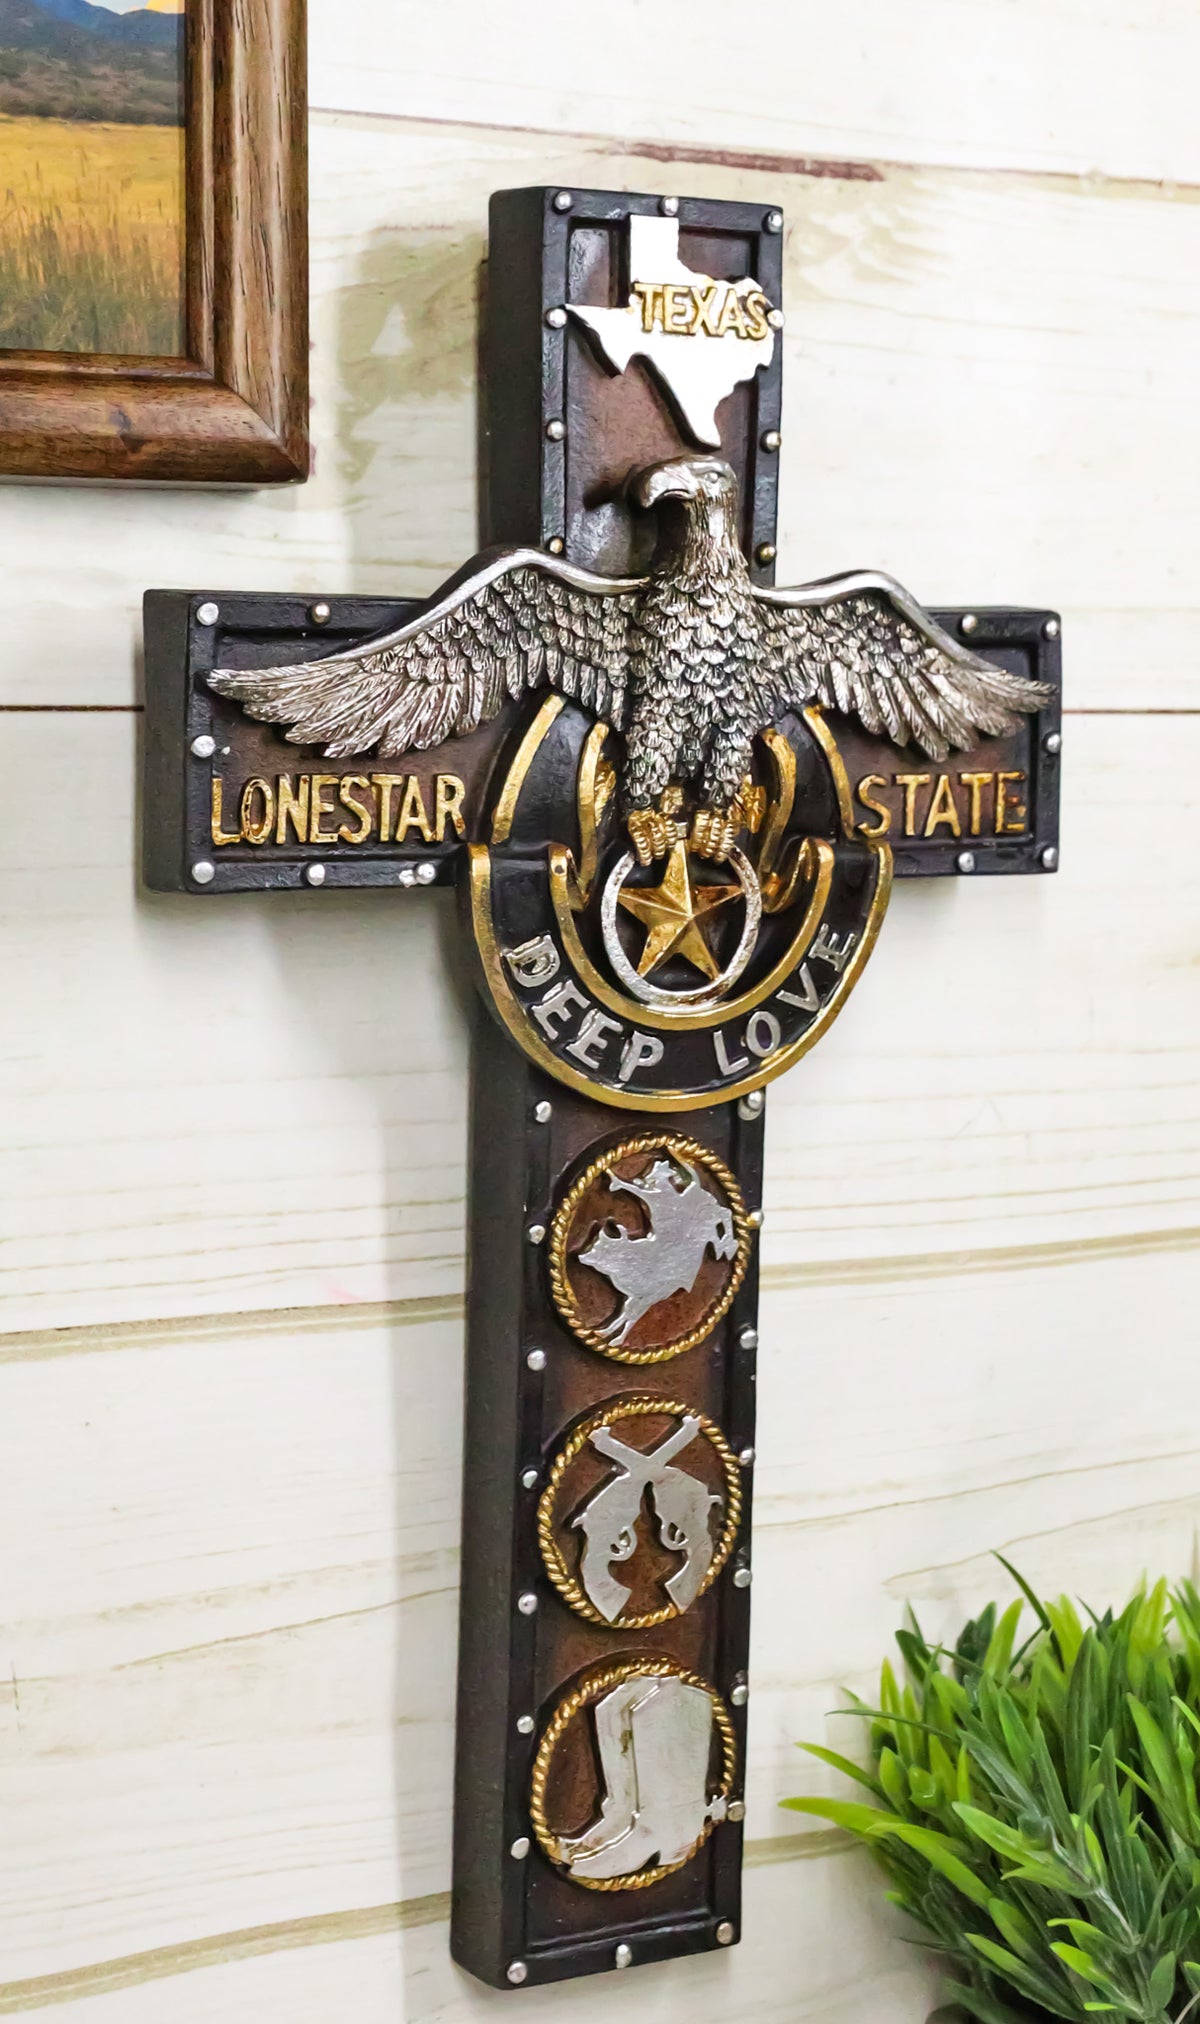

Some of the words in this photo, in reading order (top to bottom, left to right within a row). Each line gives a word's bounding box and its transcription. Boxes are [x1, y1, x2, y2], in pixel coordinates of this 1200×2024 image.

[633, 282, 768, 340] TEXAS
[211, 773, 466, 845] LONESTAR
[857, 772, 1027, 838] STATE
[503, 934, 664, 1082] DEEP
[713, 923, 857, 1076] LOVE
